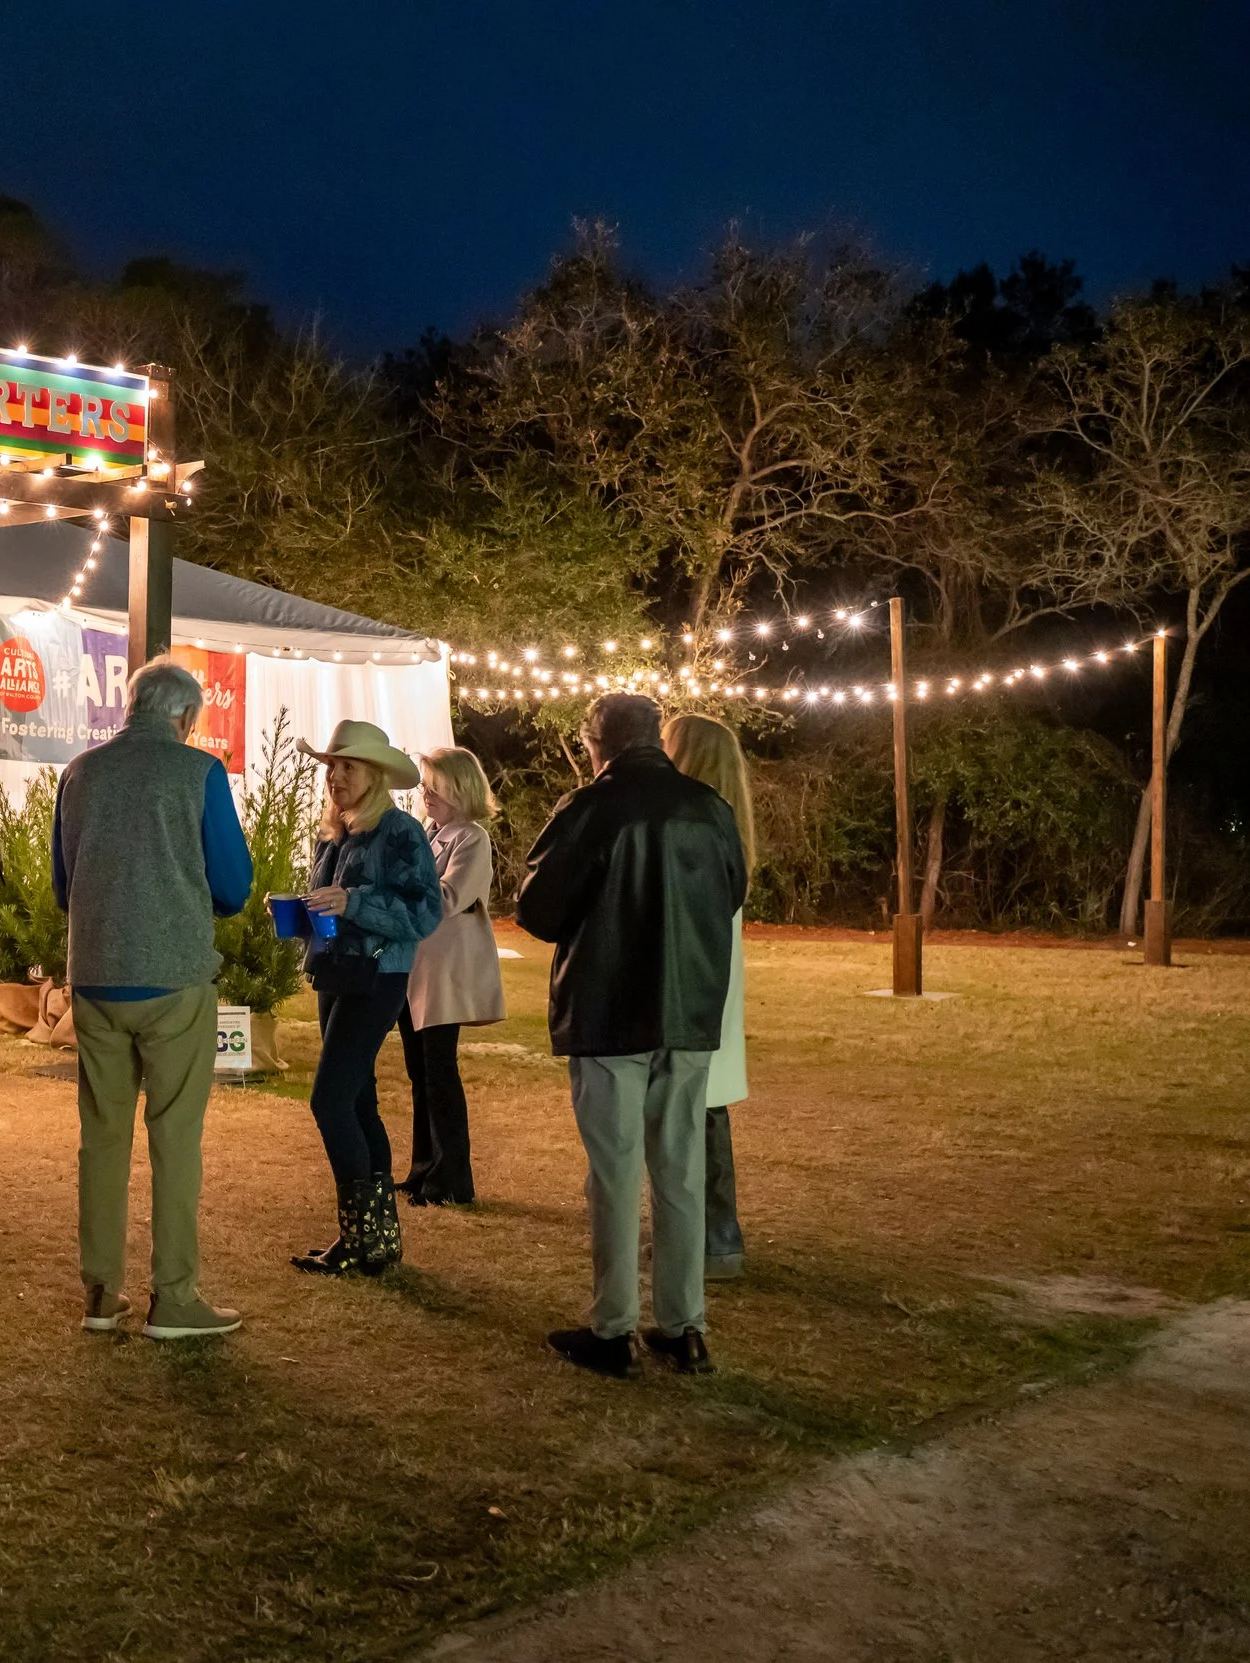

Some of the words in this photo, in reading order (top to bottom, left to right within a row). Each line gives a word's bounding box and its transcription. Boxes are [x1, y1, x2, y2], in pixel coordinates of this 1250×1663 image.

[0, 656, 39, 680] ARTS
[0, 677, 41, 695] ALLIANCE
[1, 717, 74, 744] Fostering
[191, 731, 229, 750] Years
